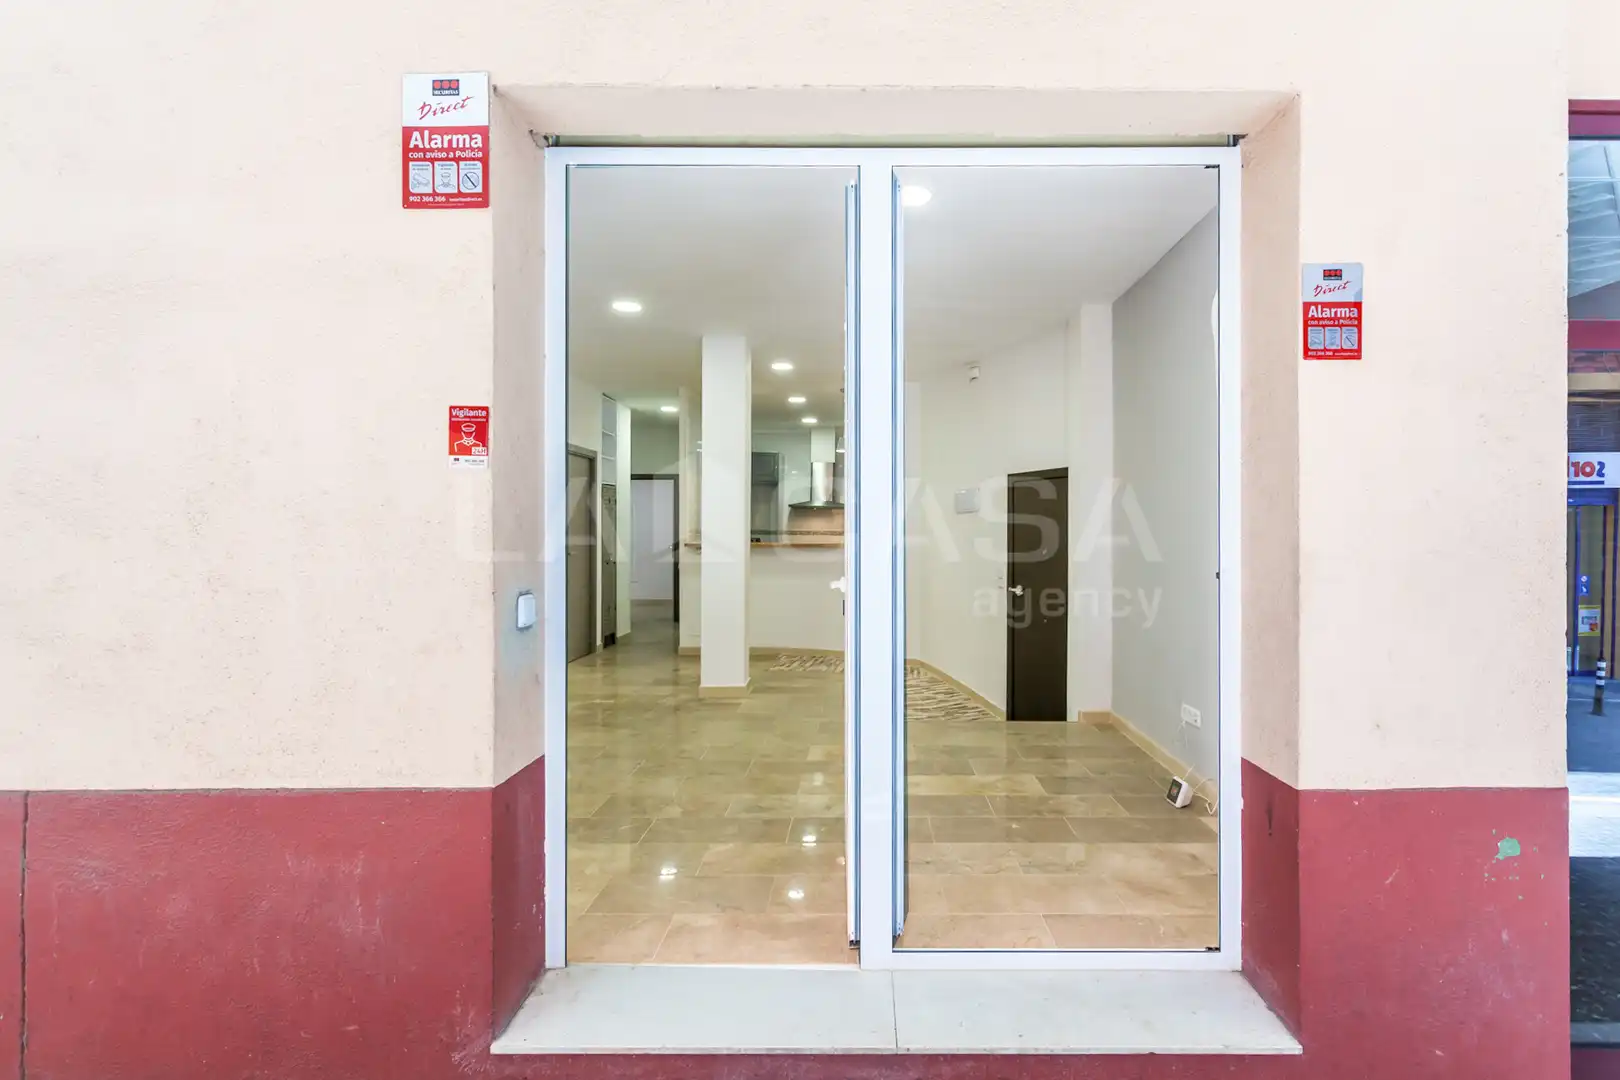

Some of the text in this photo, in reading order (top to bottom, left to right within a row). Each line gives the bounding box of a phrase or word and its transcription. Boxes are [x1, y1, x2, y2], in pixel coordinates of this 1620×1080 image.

[417, 96, 475, 120] Direct
[408, 130, 483, 149] Alarma
[425, 150, 448, 158] aviso
[455, 149, 483, 158] Policía
[1313, 280, 1352, 297] Direct
[1308, 304, 1358, 318] Alarma
[452, 408, 487, 418] Vigilante
